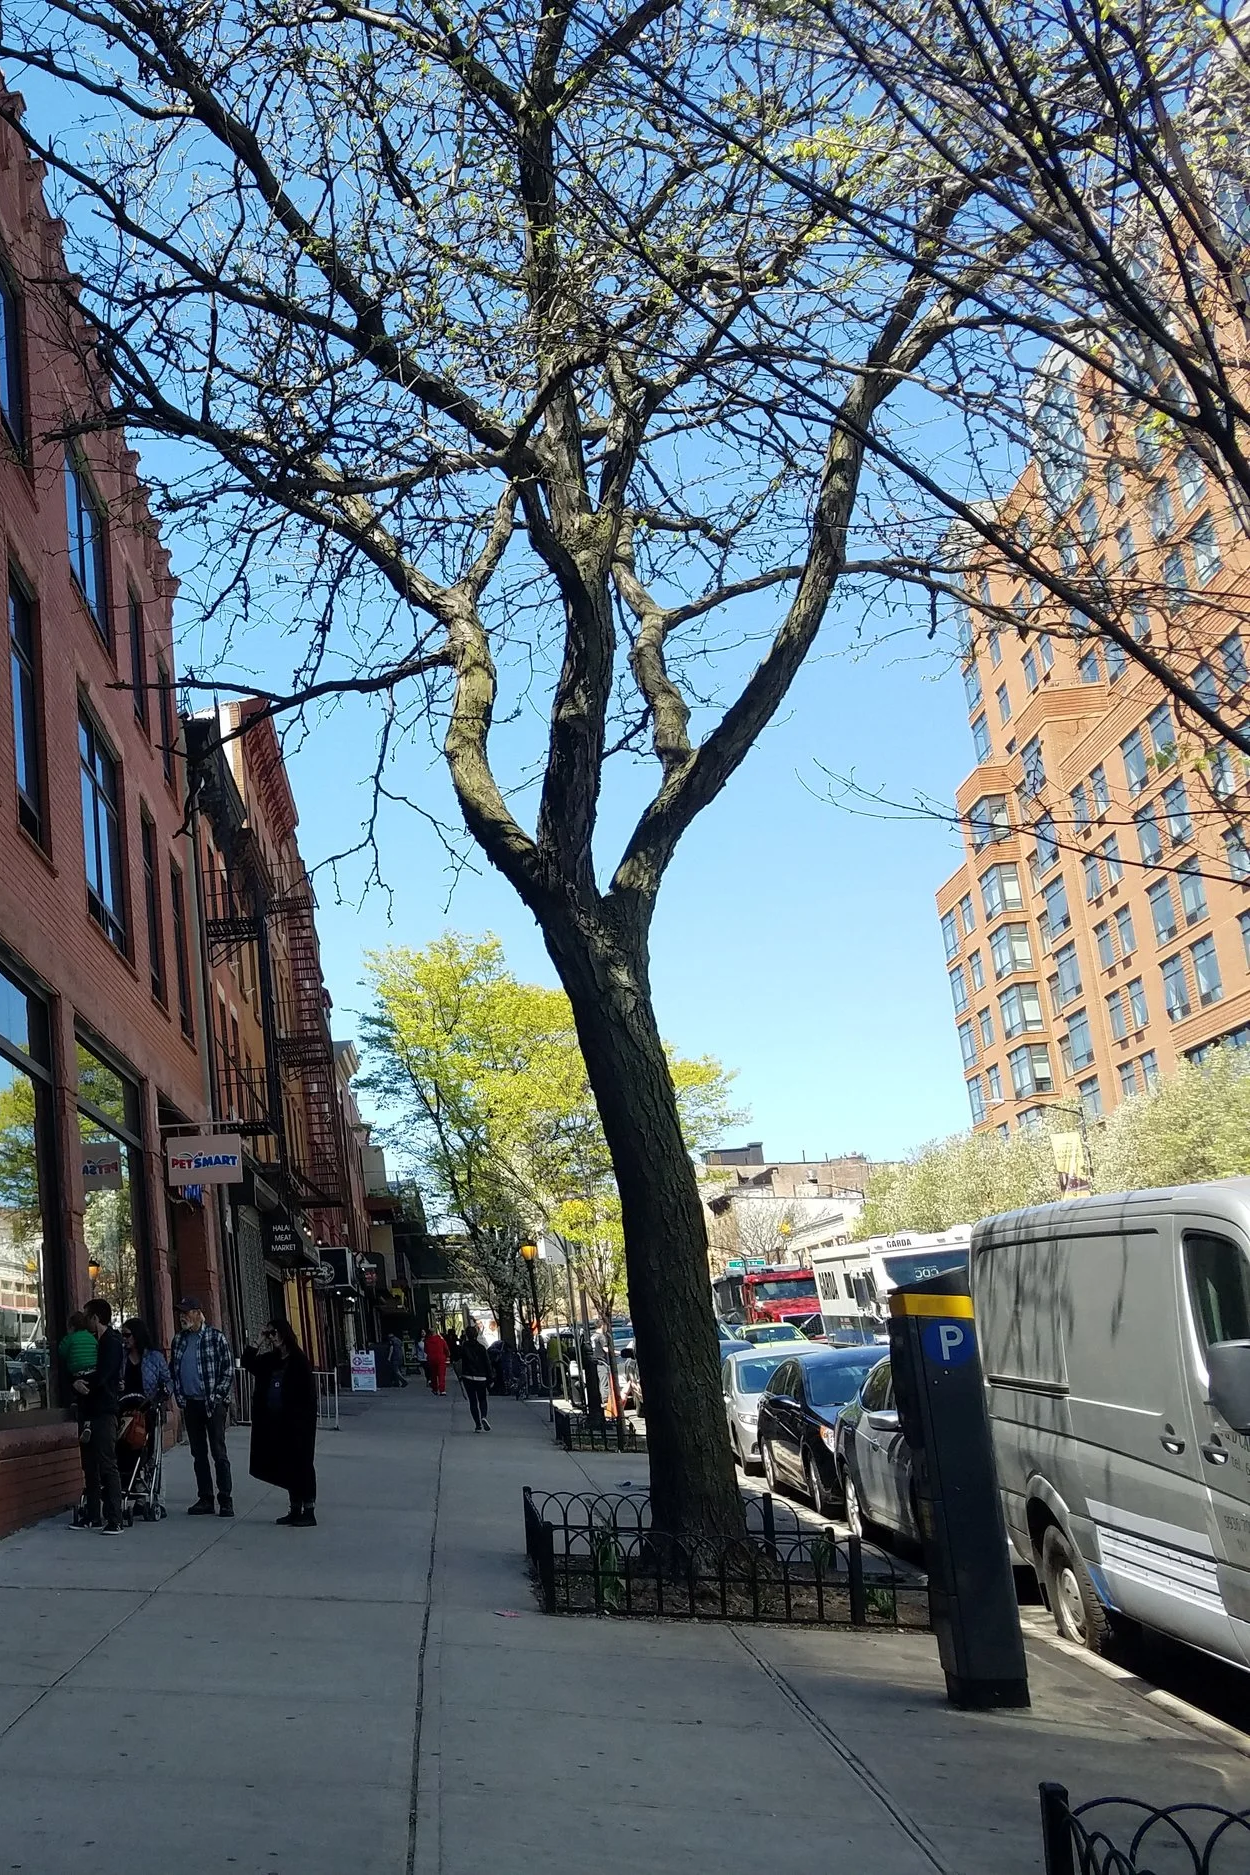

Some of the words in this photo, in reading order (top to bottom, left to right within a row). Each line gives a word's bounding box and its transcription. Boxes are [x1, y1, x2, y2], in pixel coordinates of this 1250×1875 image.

[171, 1155, 238, 1169] PETSMART
[274, 1234, 292, 1242] MEAT
[886, 1238, 912, 1249] GARDA
[271, 1243, 296, 1252] MARKET
[939, 1325, 964, 1361] P
